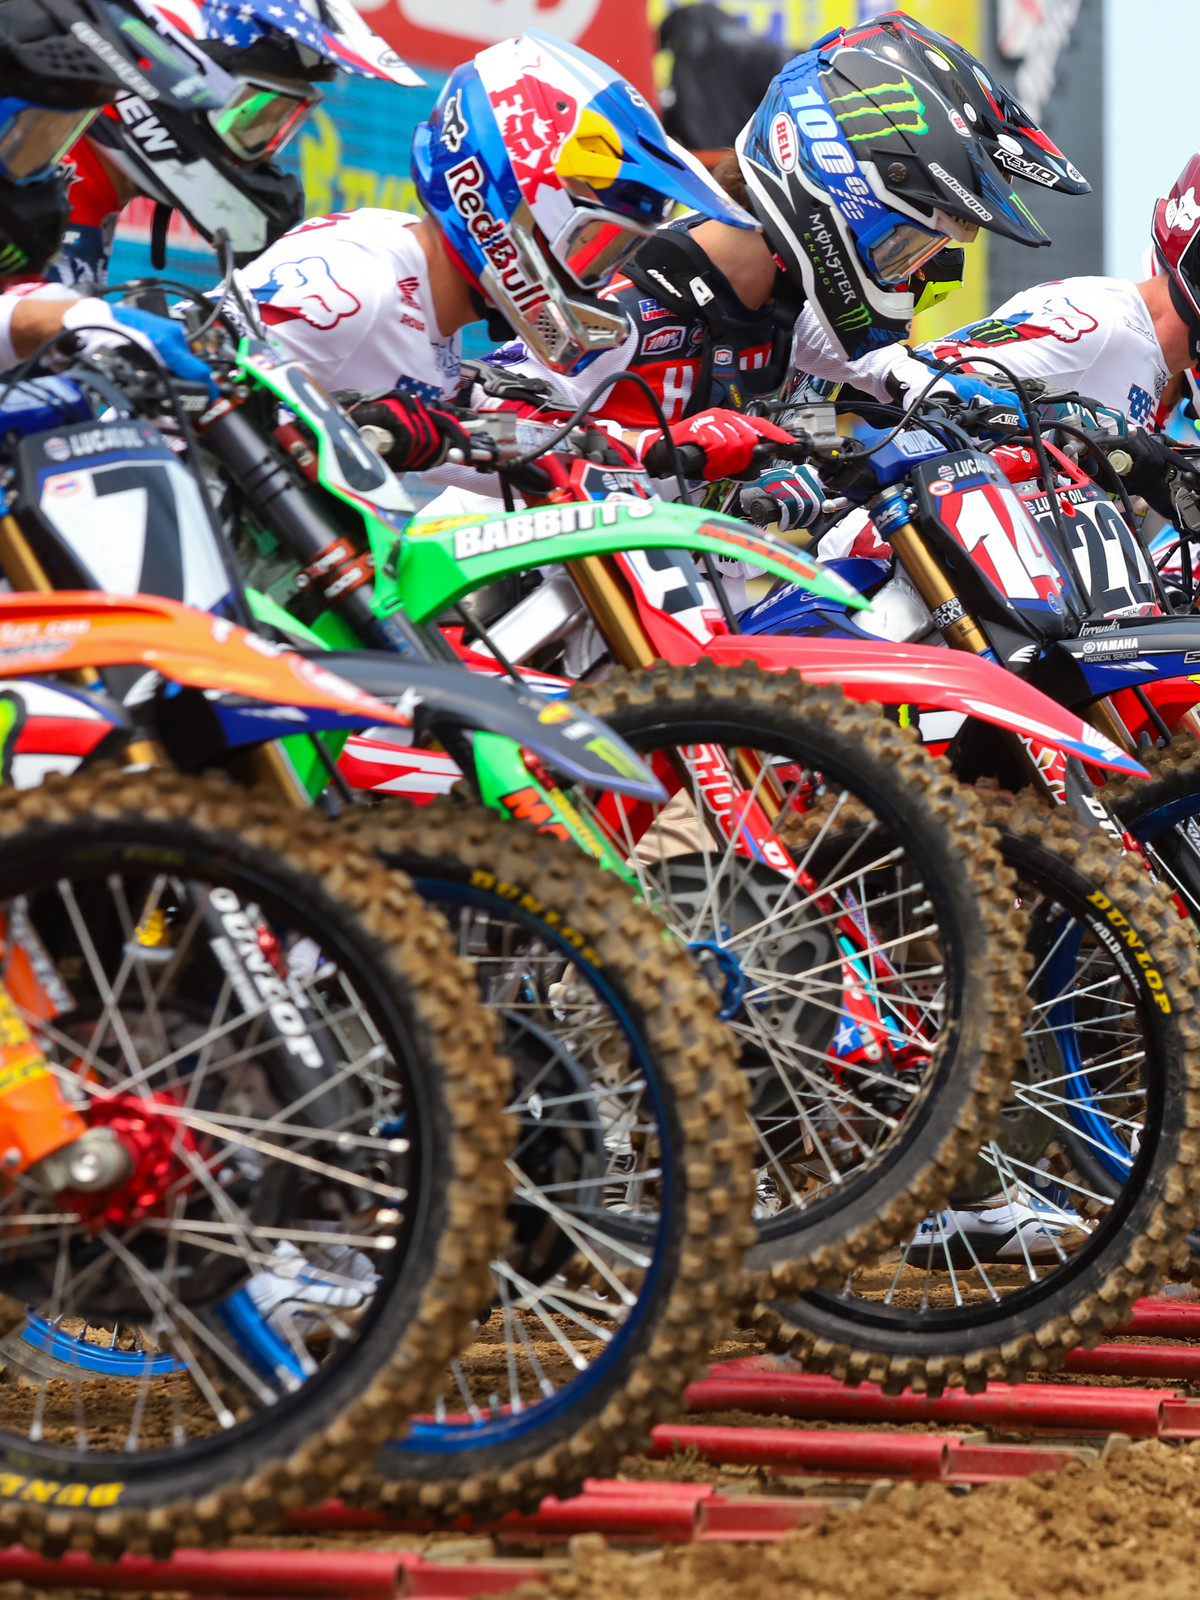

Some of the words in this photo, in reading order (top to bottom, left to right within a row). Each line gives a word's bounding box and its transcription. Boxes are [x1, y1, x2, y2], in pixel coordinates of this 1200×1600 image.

[776, 121, 788, 165] BELL
[928, 163, 993, 222] apdesigns
[482, 226, 551, 317] Bull
[804, 232, 835, 295] ENERGY
[808, 212, 856, 305] MONSTER
[648, 332, 680, 351] 100%
[689, 415, 715, 433] THOR
[988, 413, 1019, 425] ARC
[92, 465, 187, 604] 7
[955, 487, 1065, 600] 14
[933, 606, 964, 629] OCKY
[1078, 618, 1121, 639] Ferrandis
[1083, 653, 1112, 664] FINANCIAL
[1111, 651, 1139, 662] SERVICES
[1095, 637, 1139, 652] YAMAHA
[1085, 890, 1172, 1014] DUNLOP
